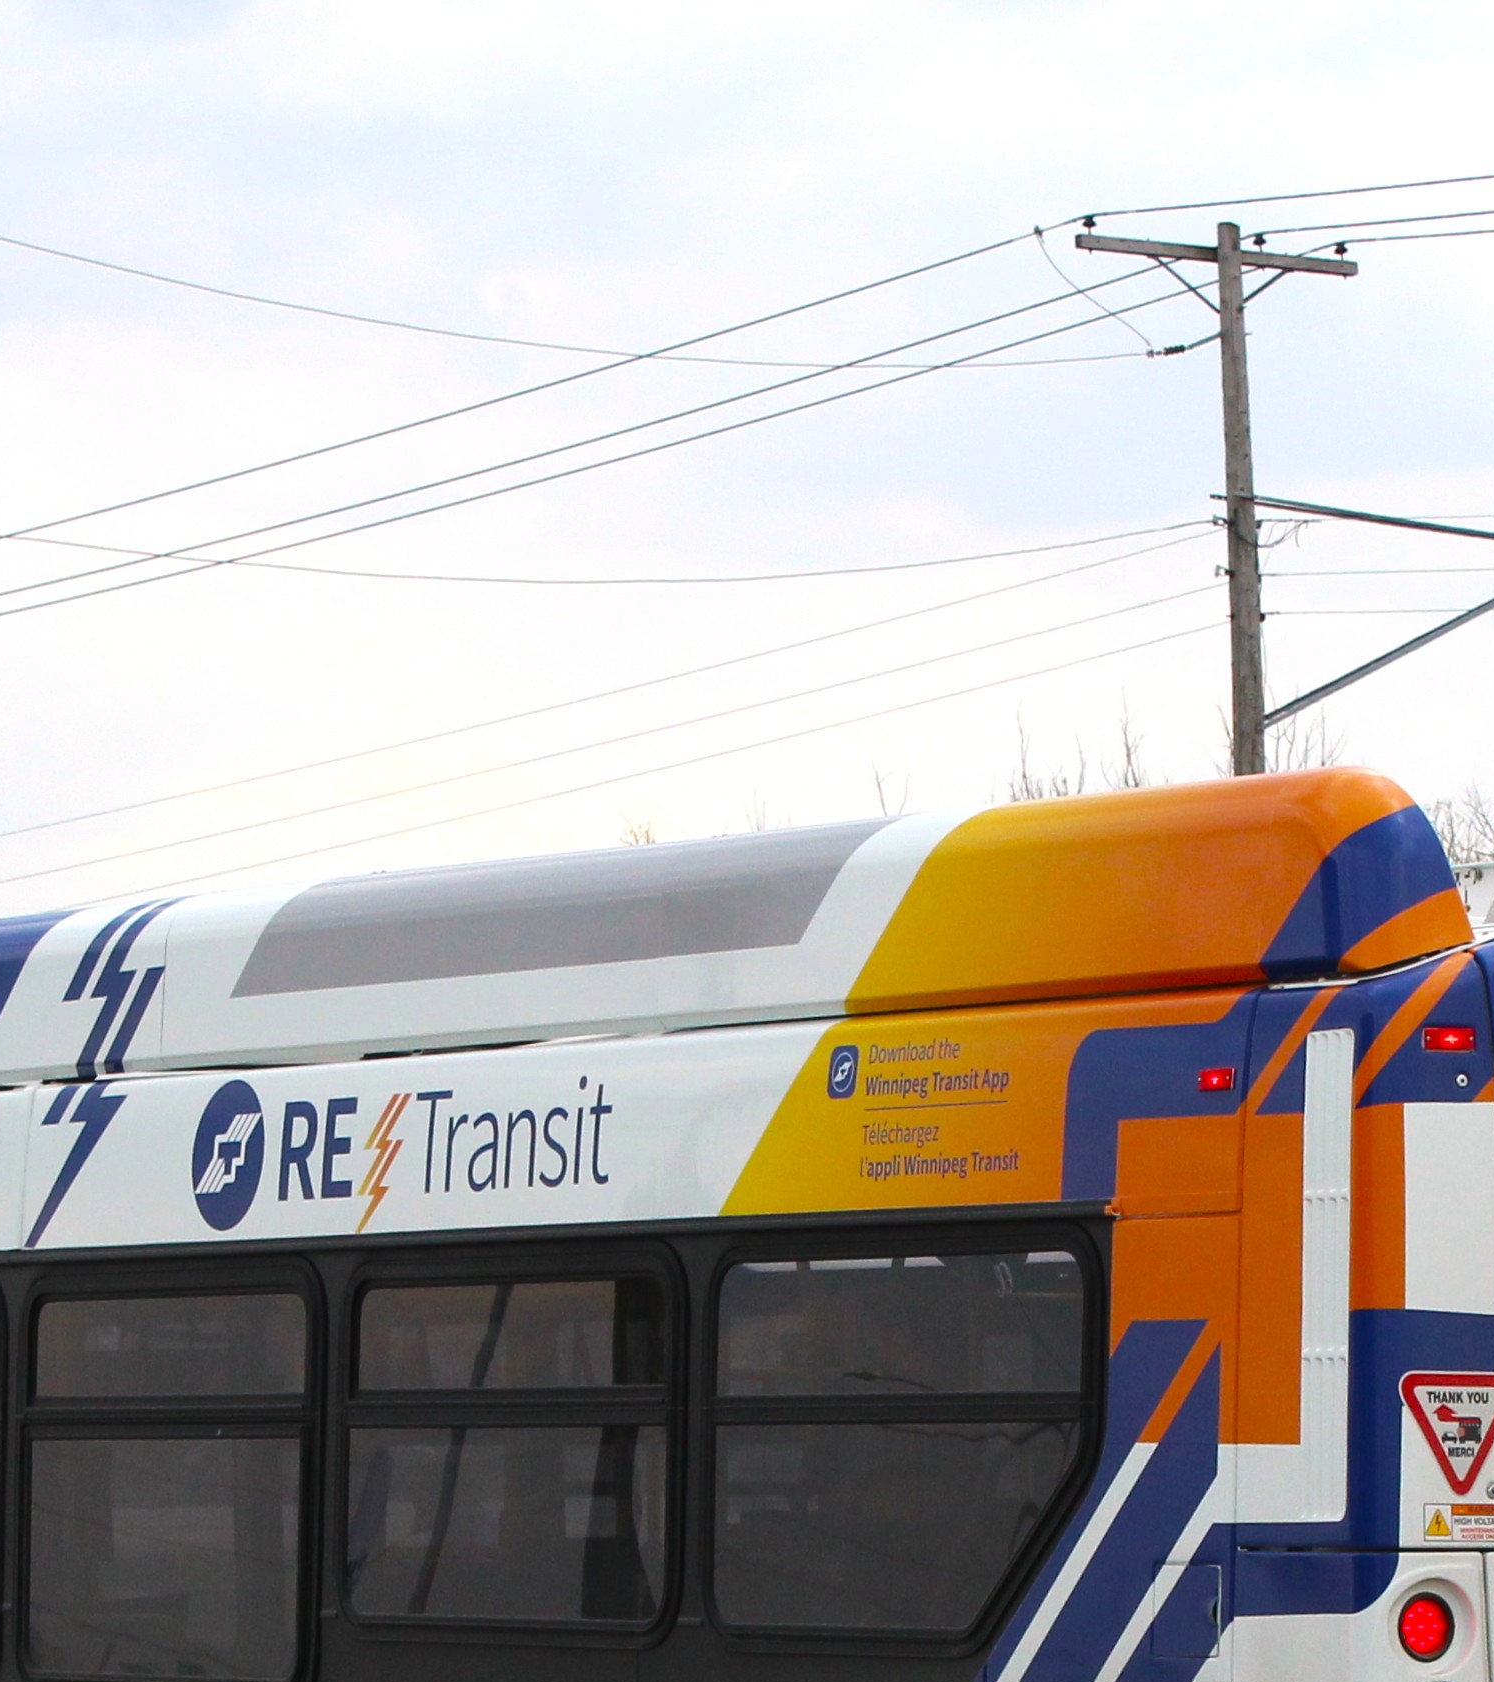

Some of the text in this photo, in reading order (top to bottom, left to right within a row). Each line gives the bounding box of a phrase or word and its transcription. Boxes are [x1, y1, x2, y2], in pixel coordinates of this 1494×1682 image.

[869, 1038, 960, 1064] Download the
[866, 1068, 1009, 1099] Winnipeg Transit App
[278, 1075, 613, 1202] RE Transit
[863, 1121, 939, 1148] Téléchargez
[860, 1149, 1020, 1181] l'appli Winnipeg Transit
[1427, 1391, 1490, 1404] THANK YOU
[1448, 1446, 1475, 1457] MERCI
[1454, 1518, 1472, 1526] HIGH
